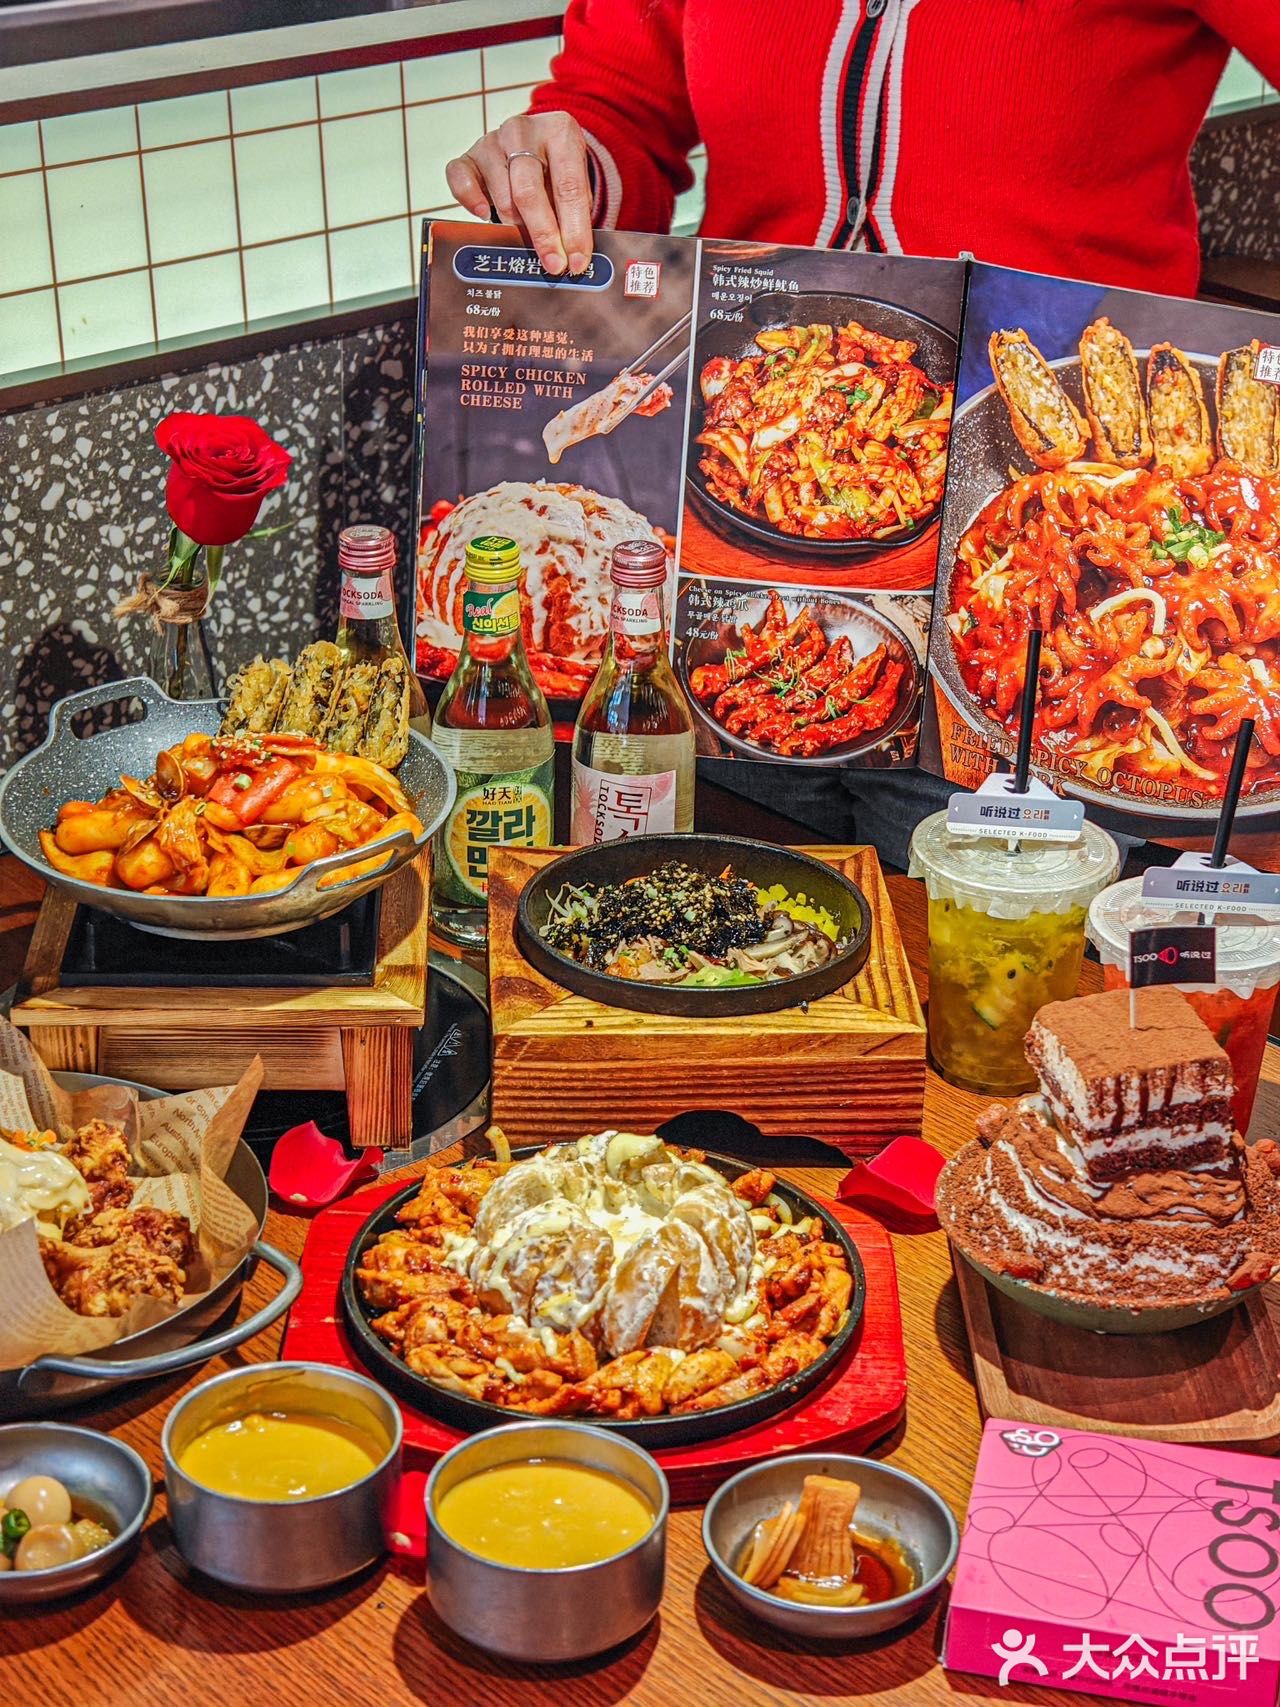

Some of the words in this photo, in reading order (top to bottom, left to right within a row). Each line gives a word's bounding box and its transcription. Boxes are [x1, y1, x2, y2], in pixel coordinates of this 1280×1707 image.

[473, 254, 595, 279] 芝士熔岩
[630, 265, 655, 280] 特色
[712, 264, 731, 274] Spicy
[734, 266, 752, 274] Fried
[754, 268, 774, 277] Squid
[630, 280, 655, 294] 推荐
[712, 273, 800, 293] 韩式辣炒鲜鱿鱼
[466, 304, 501, 317] 68元/份
[709, 308, 744, 322] 68元/份
[462, 340, 594, 362] 只为了拥有理想的生活
[461, 364, 508, 379] SPICY
[515, 368, 587, 385] CHICKEN
[460, 379, 527, 395] ROLLED
[534, 383, 574, 399] WITH
[460, 394, 523, 409] CHEESE
[725, 589, 742, 598] Spicy
[465, 597, 494, 618] Real
[686, 626, 719, 640] 48元/份
[950, 743, 1000, 774] WITH
[951, 721, 1013, 758] FRIED
[1097, 766, 1205, 809] OCTOPUS
[482, 785, 512, 801] 好天
[980, 805, 1021, 820] 听说过
[466, 805, 536, 842] 깔라
[979, 828, 1017, 837] SELECTED
[1176, 880, 1219, 893] 听说过
[1175, 902, 1214, 910] SELECTED
[1133, 952, 1159, 964] TSOO
[172, 1107, 195, 1131] North
[1203, 1478, 1280, 1632] TSOO
